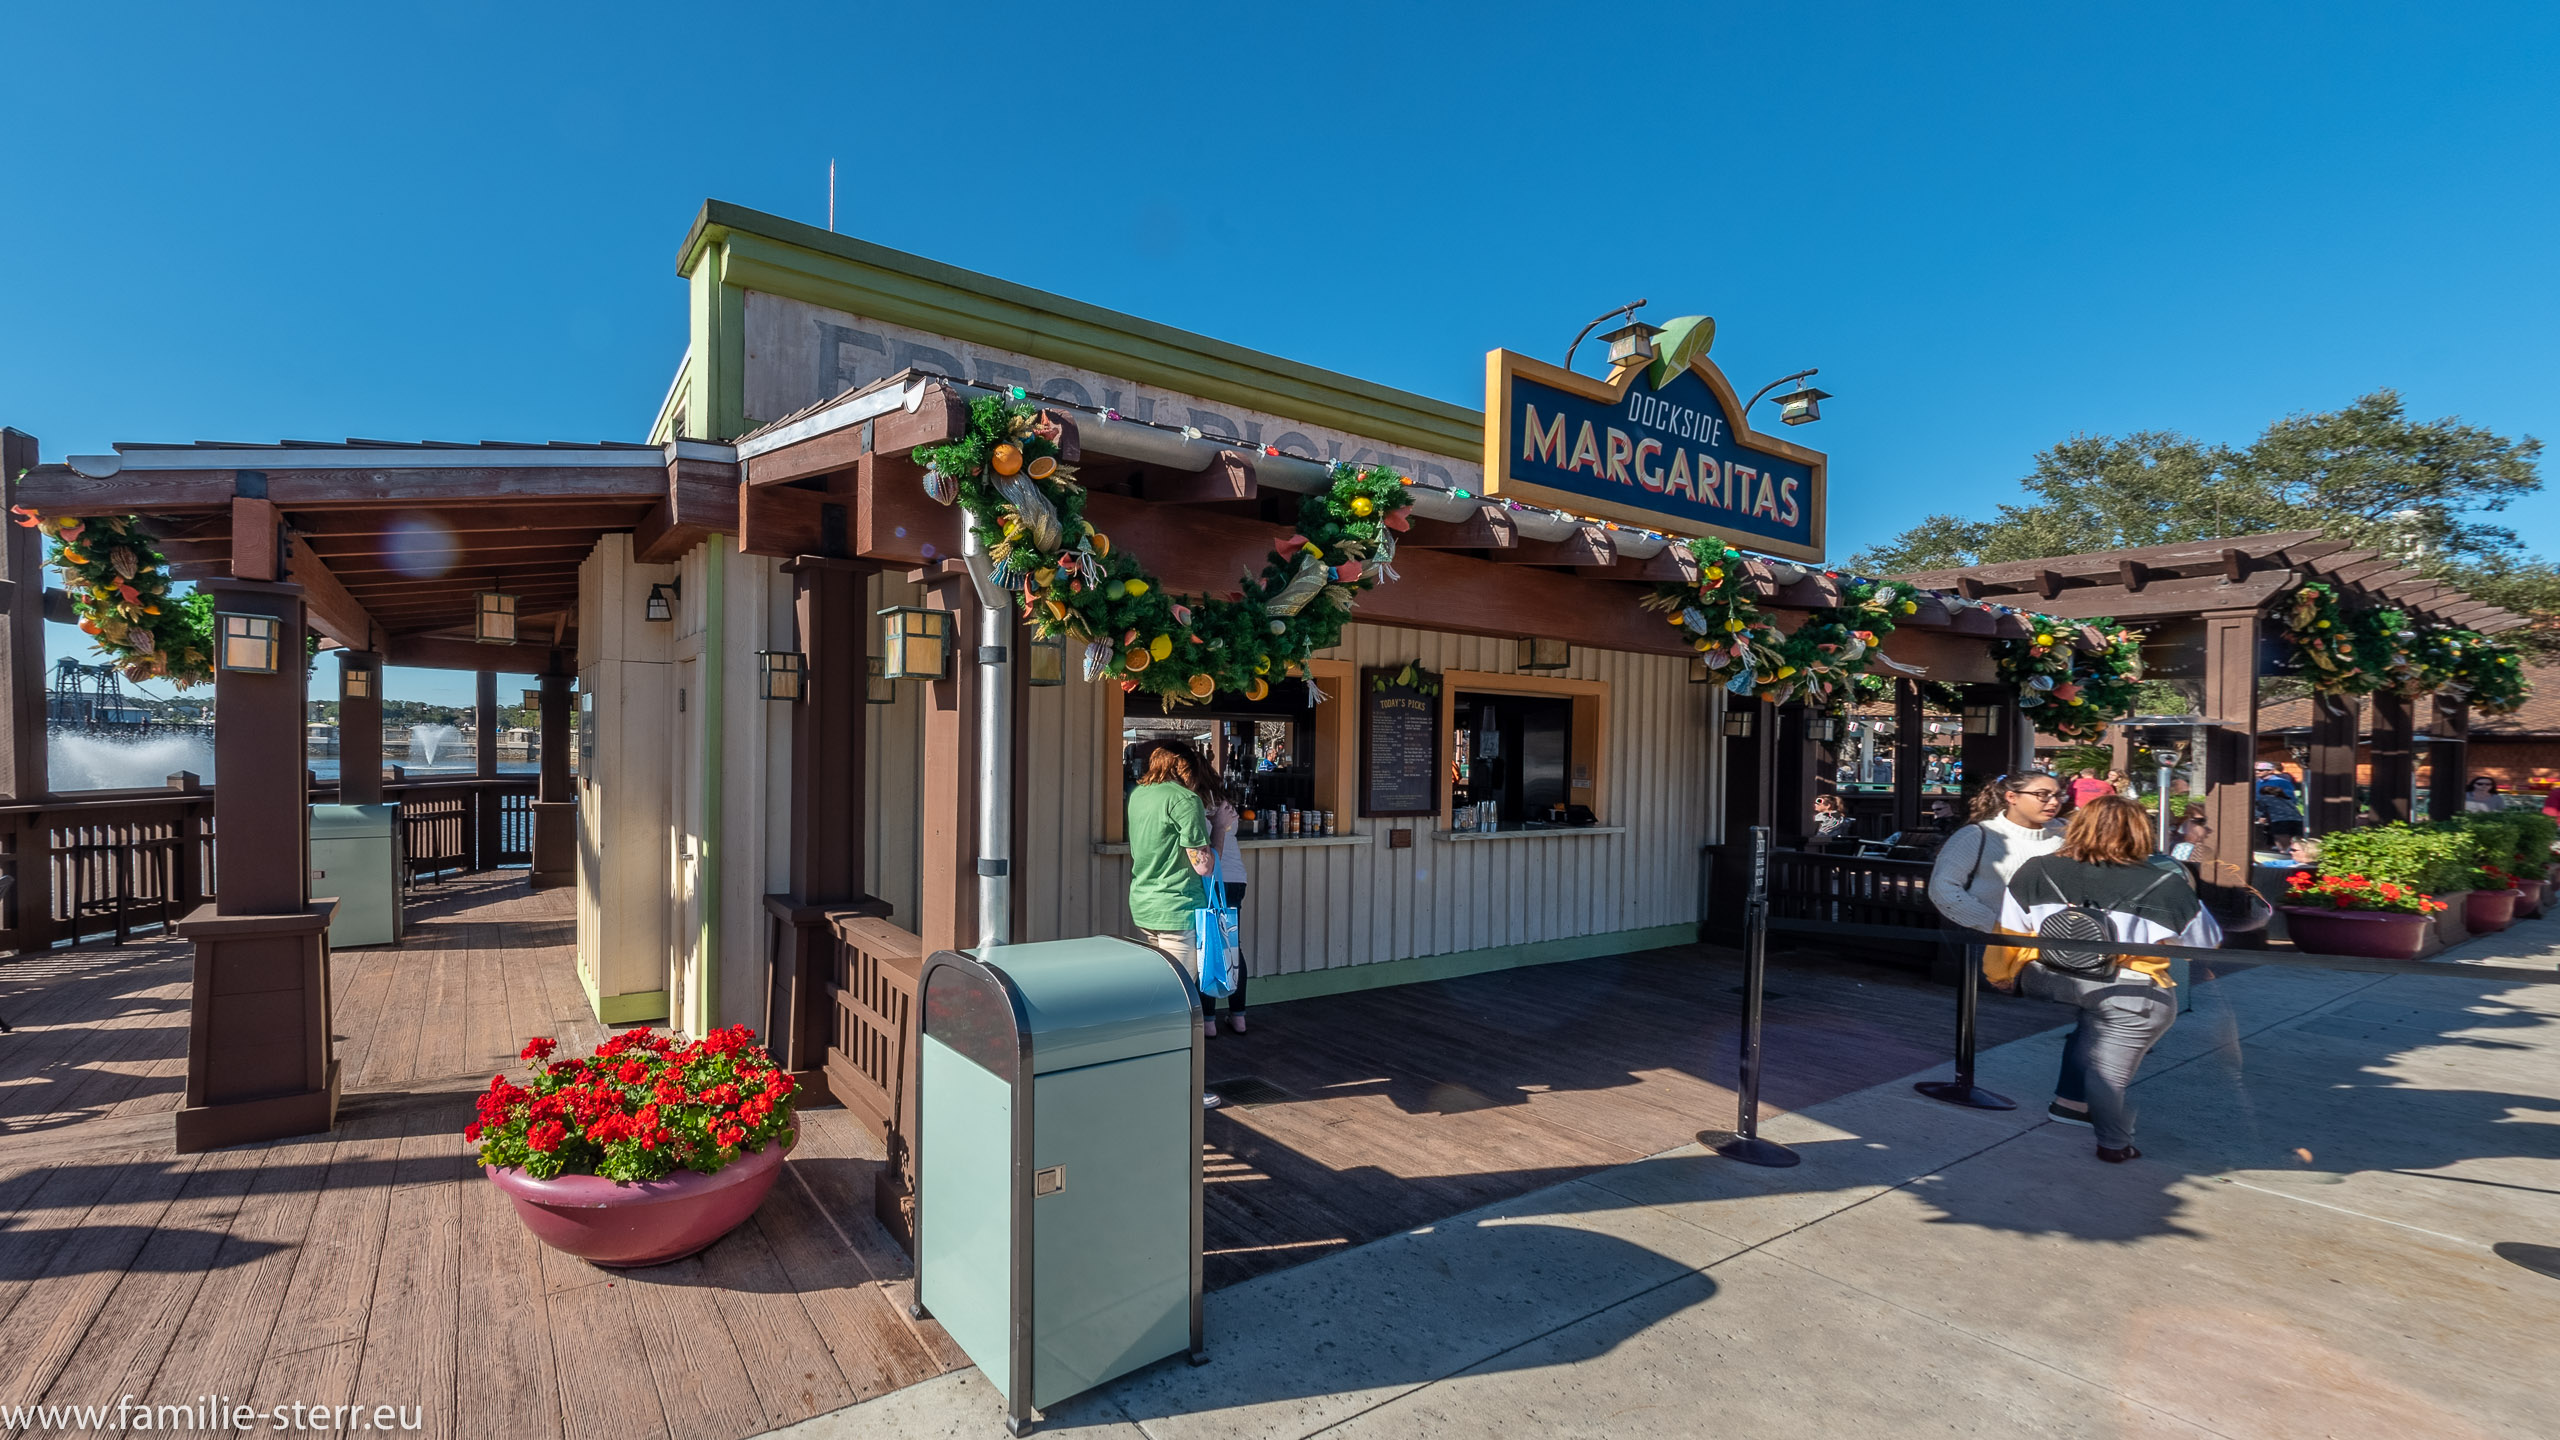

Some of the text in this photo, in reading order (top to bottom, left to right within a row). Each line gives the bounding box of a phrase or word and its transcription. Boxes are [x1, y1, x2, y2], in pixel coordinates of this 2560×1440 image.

[1628, 391, 1723, 447] DOCKSIDE
[1523, 403, 1799, 528] MARGARITAS
[1380, 698, 1425, 711] TODAY'S PICKS
